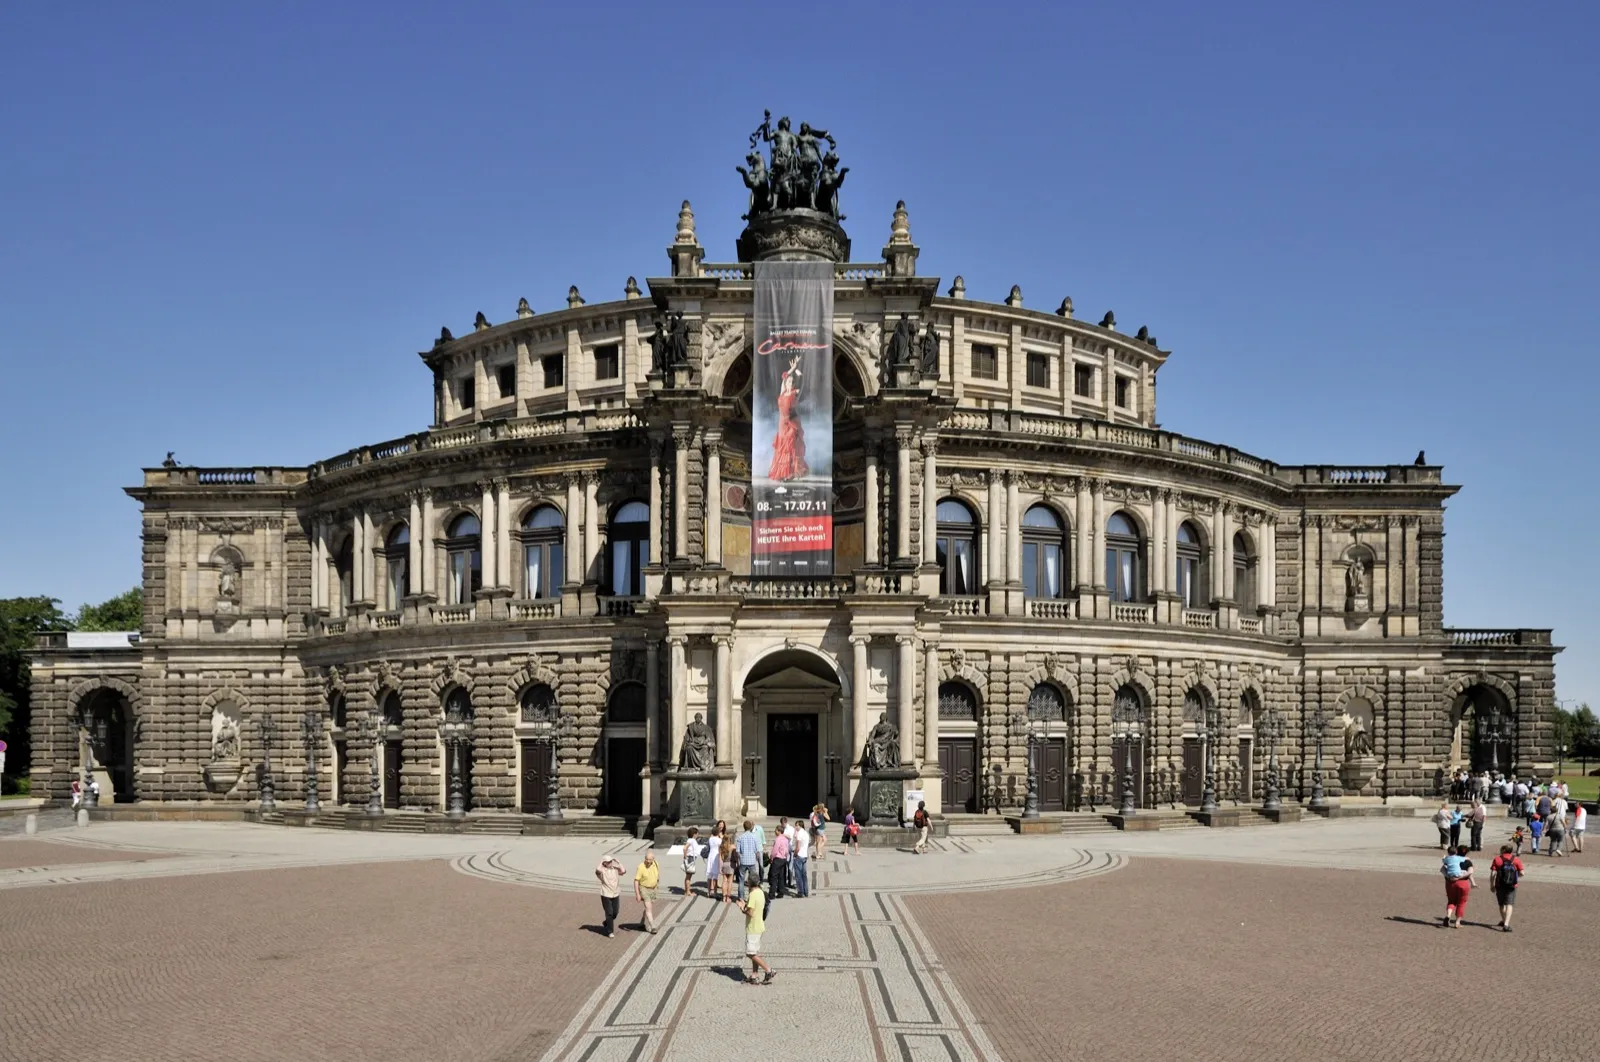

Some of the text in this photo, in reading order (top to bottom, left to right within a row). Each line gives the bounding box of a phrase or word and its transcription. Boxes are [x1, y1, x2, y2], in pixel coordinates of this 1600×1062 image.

[756, 502, 772, 511] 08.
[784, 501, 826, 510] 17.07.11
[760, 527, 782, 535] Sichern
[757, 536, 780, 544] HEUTE
